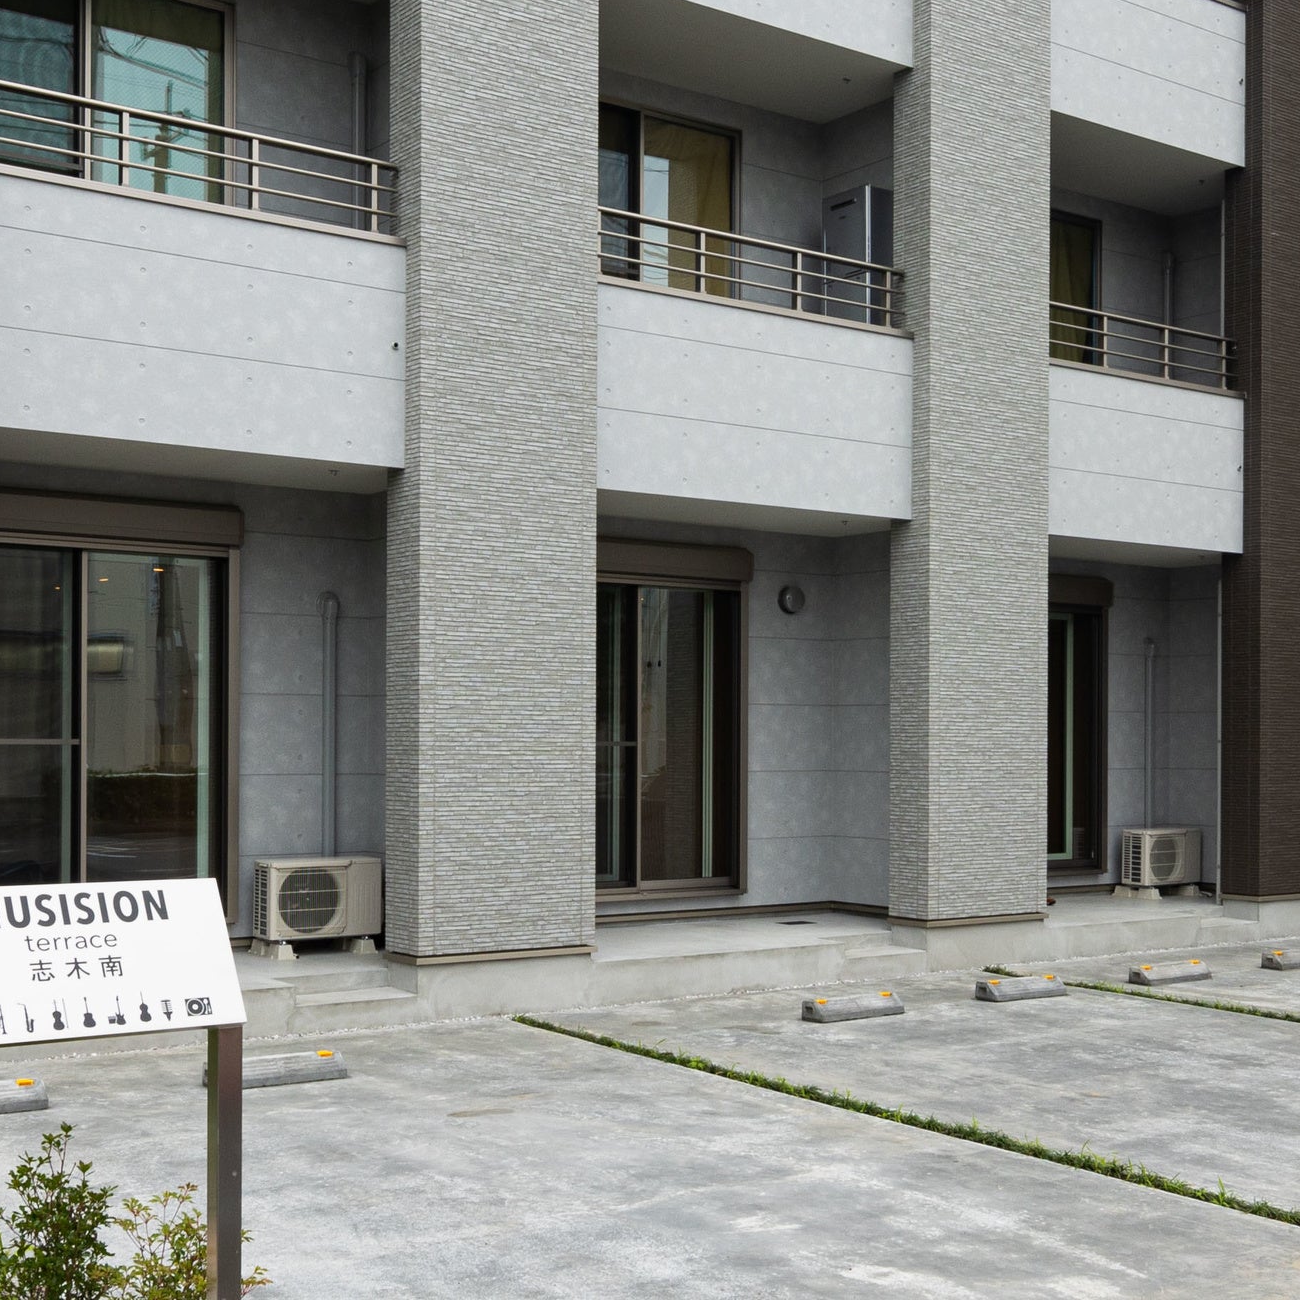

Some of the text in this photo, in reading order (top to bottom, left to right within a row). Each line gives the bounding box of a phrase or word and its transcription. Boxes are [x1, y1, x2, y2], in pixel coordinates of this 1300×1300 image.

[24, 933, 118, 952] terrace
[29, 955, 124, 982] 志木南
